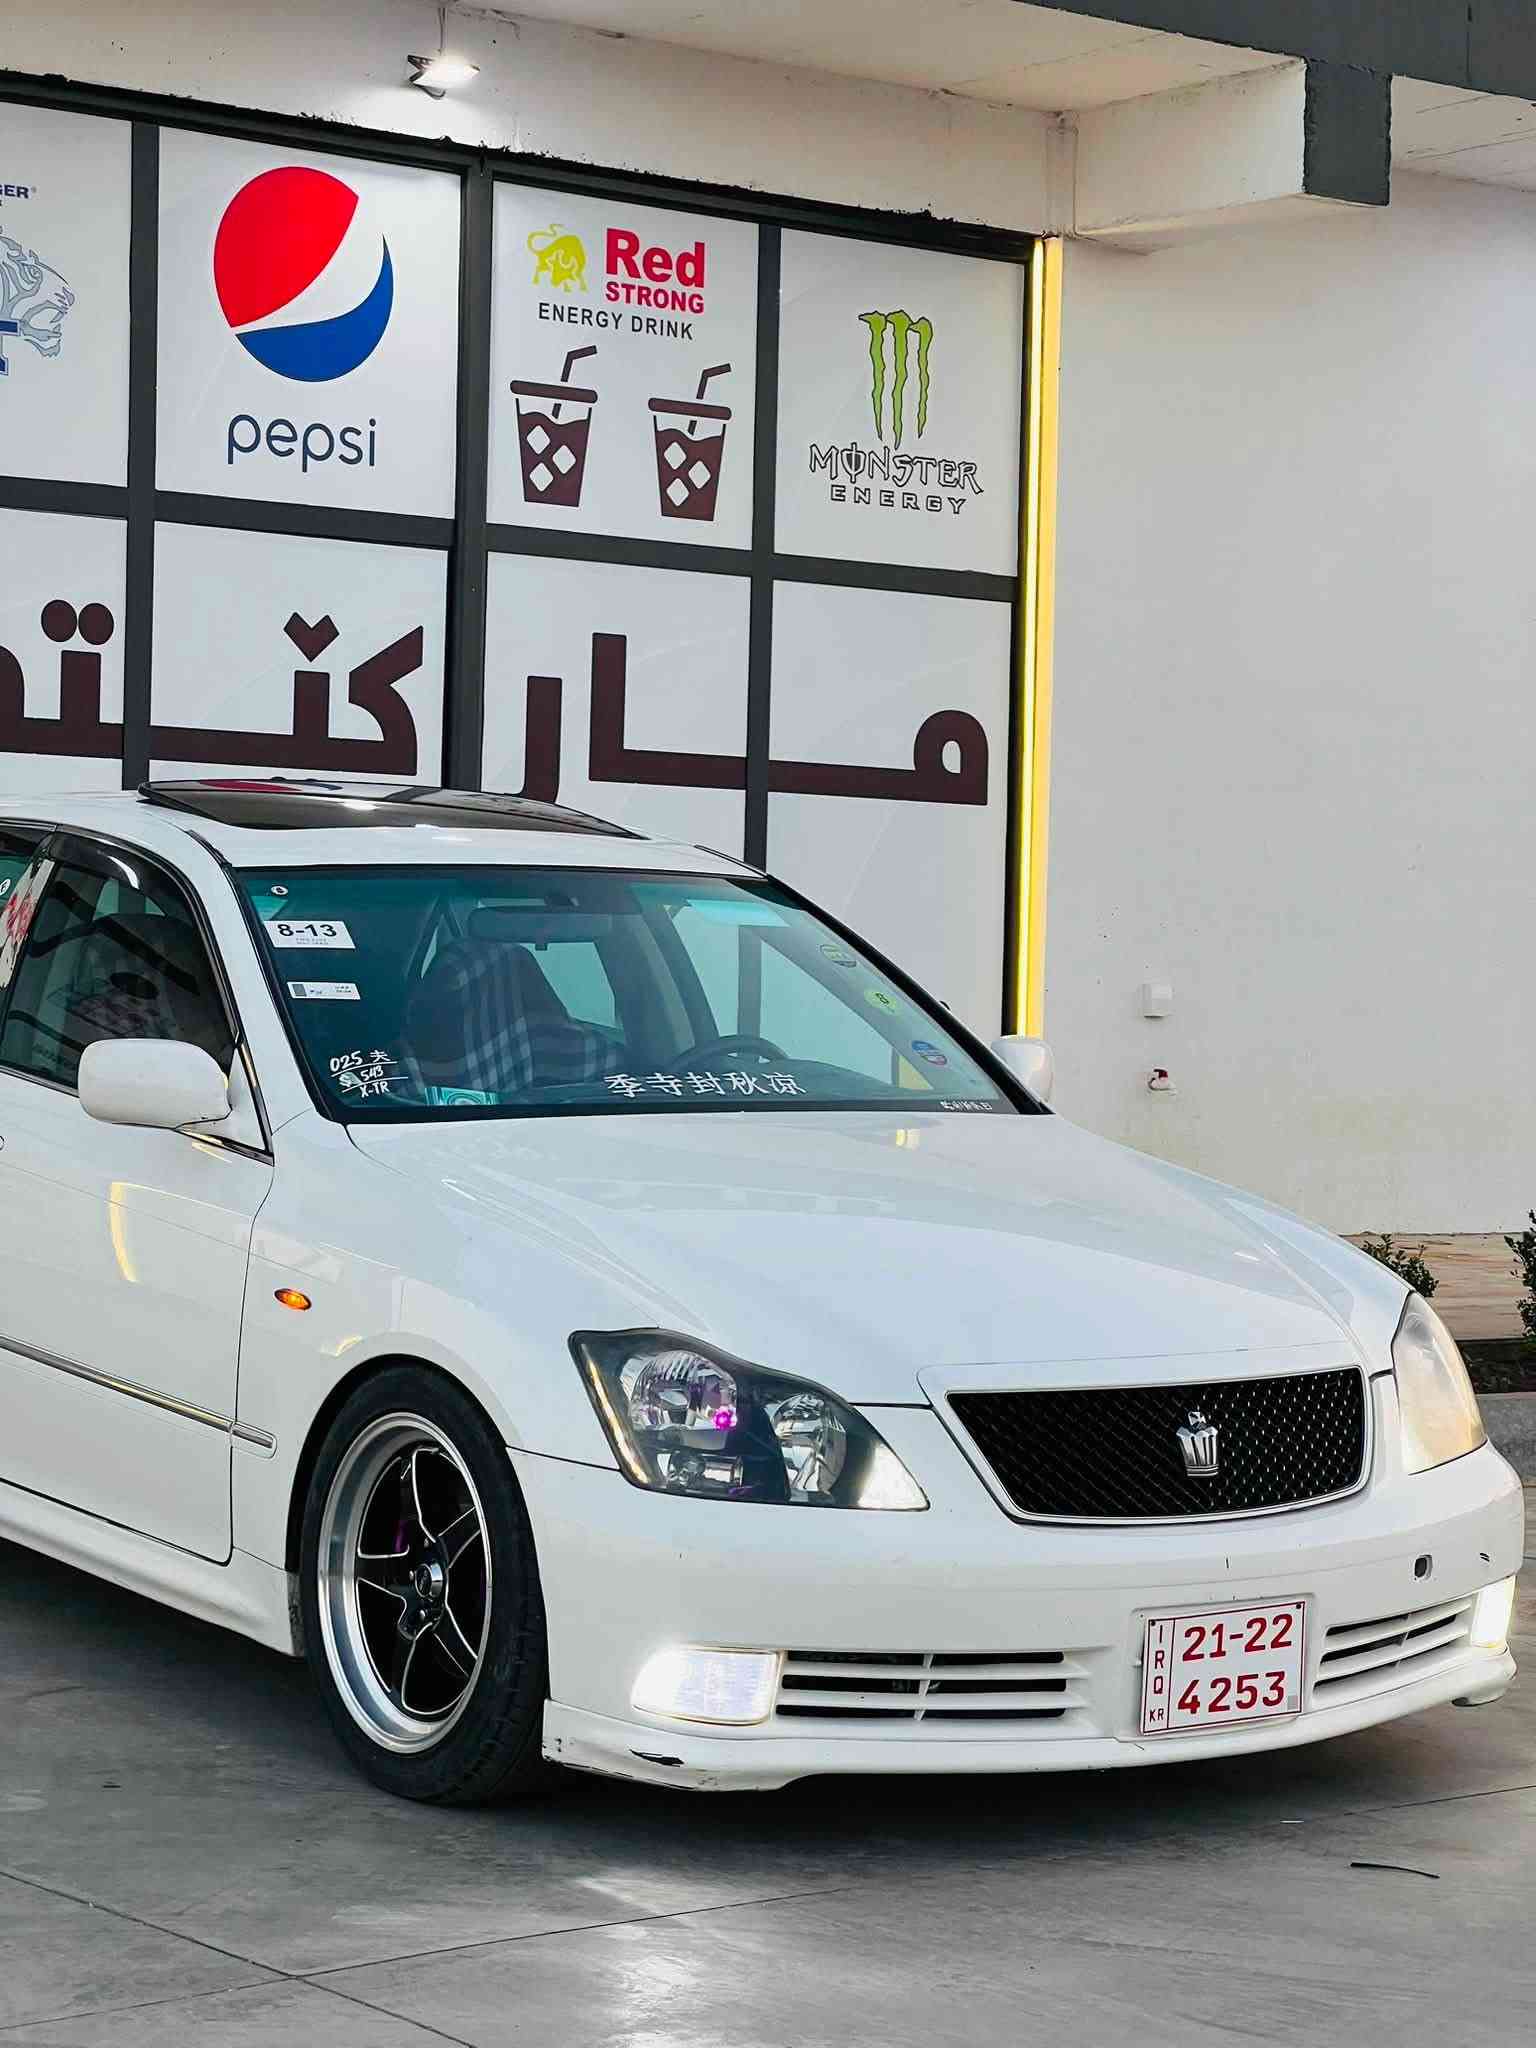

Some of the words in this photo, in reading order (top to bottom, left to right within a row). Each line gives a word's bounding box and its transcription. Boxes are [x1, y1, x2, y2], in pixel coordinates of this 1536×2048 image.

[0, 184, 29, 199] ER
[606, 228, 705, 288] Red
[605, 281, 704, 314] STRONG
[538, 302, 623, 330] ENERGY
[631, 315, 693, 340] DRINK
[227, 414, 377, 472] pepsi
[809, 442, 984, 494] MONSTER
[830, 484, 966, 514] ENERGY
[277, 924, 337, 937] 8-13
[330, 1050, 363, 1072] 025
[360, 1065, 384, 1081] 543
[360, 1081, 391, 1098] X-TR
[1182, 1613, 1293, 1662] 21-22
[1177, 1670, 1286, 1714] 4253
[1149, 1708, 1165, 1722] KR
